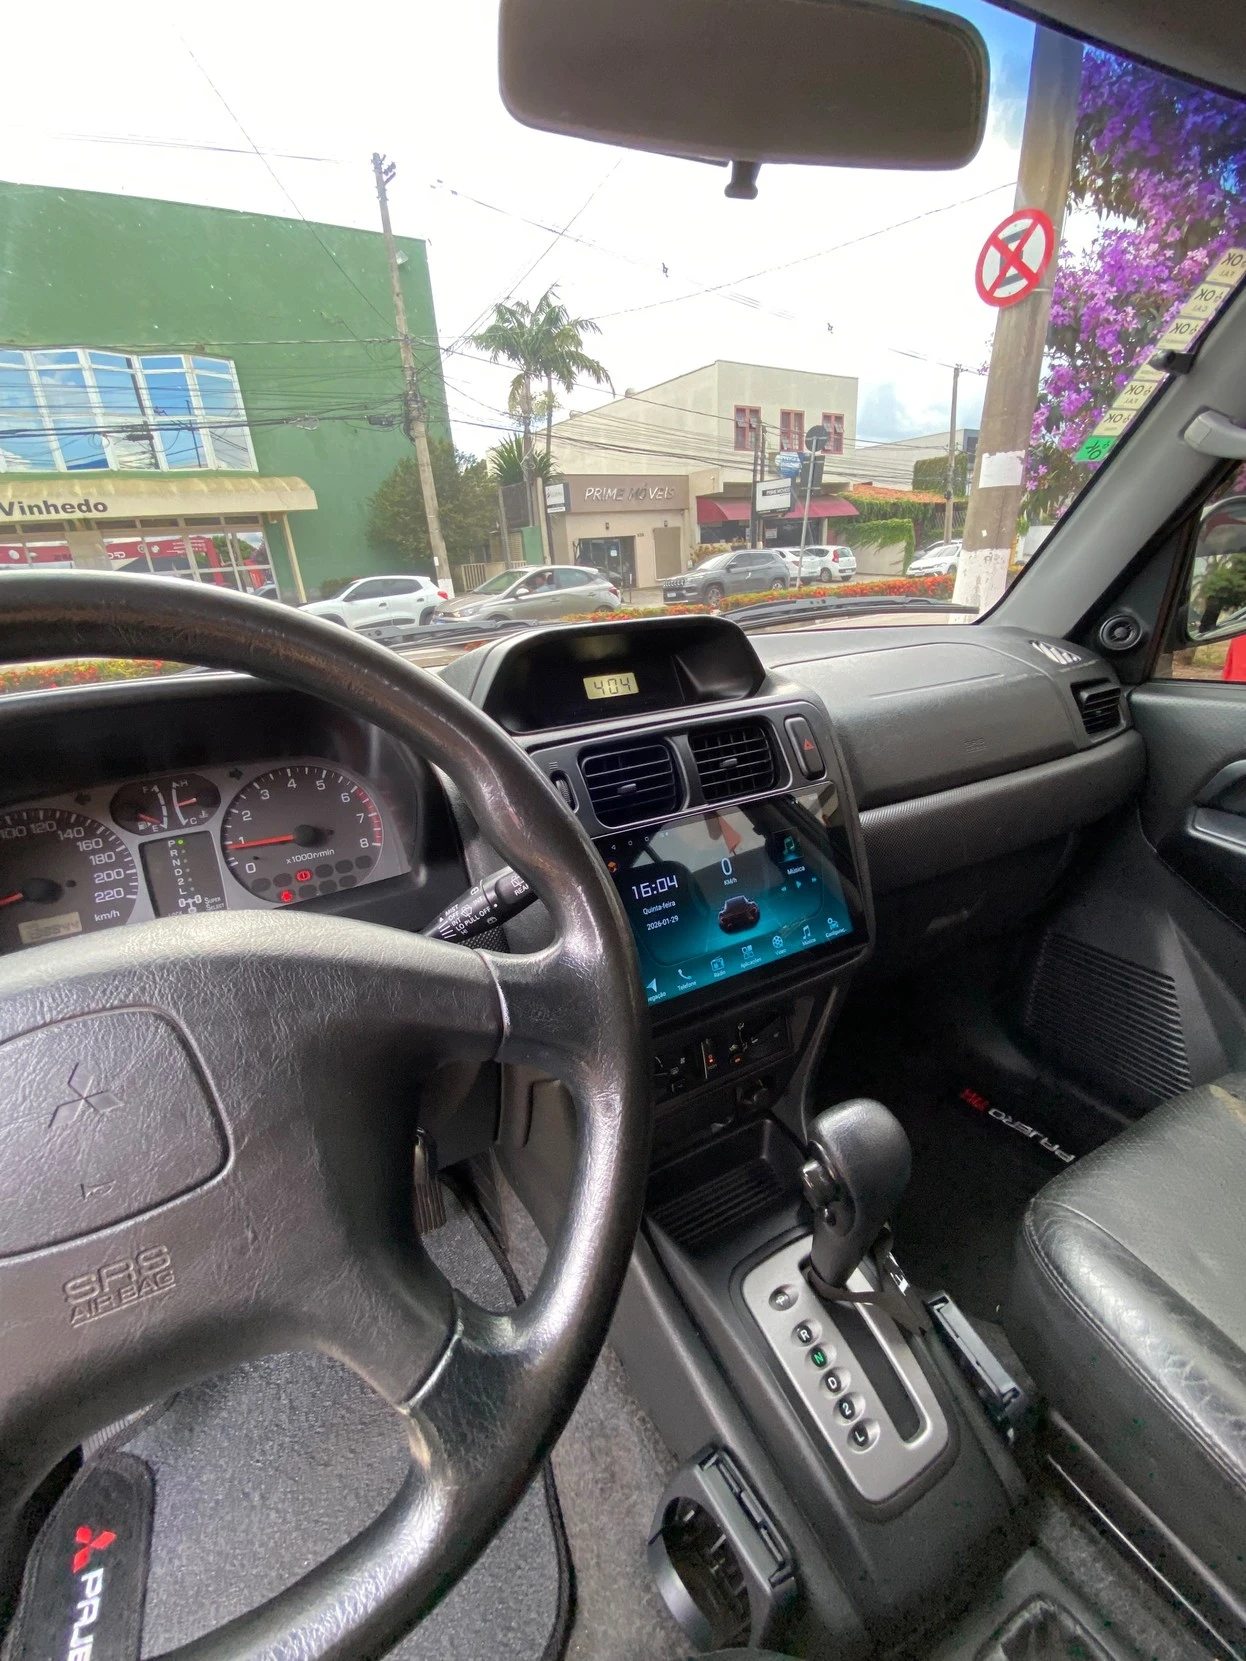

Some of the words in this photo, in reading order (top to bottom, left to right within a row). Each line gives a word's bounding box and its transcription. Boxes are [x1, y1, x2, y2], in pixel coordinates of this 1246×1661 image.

[584, 487, 624, 501] PRIME
[0, 499, 108, 516] Vinhedo
[594, 677, 631, 695] 404
[287, 778, 297, 788] 4
[315, 780, 326, 791] 5
[260, 789, 270, 800] 3
[340, 792, 350, 803] 6
[190, 817, 198, 825] C
[241, 810, 252, 821] 2
[356, 812, 365, 824] 7
[30, 820, 57, 834] 120
[152, 824, 159, 832] E
[57, 826, 85, 841] 140
[76, 838, 103, 851] 160
[167, 839, 176, 848] P
[359, 838, 369, 849] 8
[89, 851, 116, 865] 180
[170, 849, 178, 857] R
[172, 858, 181, 867] N
[245, 862, 257, 874] 0
[721, 857, 733, 876] 0
[94, 868, 124, 884] 200
[174, 868, 183, 876] D
[177, 877, 185, 886] 2
[631, 875, 679, 900] 16:04
[94, 887, 124, 903] 220
[179, 887, 187, 895] L
[445, 904, 459, 916] MIST
[642, 900, 677, 915] Quinta-feira
[94, 909, 120, 922] km/h
[448, 911, 460, 921] OFF
[464, 915, 480, 926] PULL
[479, 906, 491, 917] OFF
[455, 923, 465, 932] LO
[646, 915, 679, 931] 2026-01-29
[62, 1244, 171, 1305] SRS
[776, 1294, 788, 1306] P
[800, 1329, 811, 1341] R
[813, 1351, 825, 1364] N
[827, 1376, 838, 1390] D
[842, 1402, 852, 1416] 2
[855, 1431, 865, 1442] L
